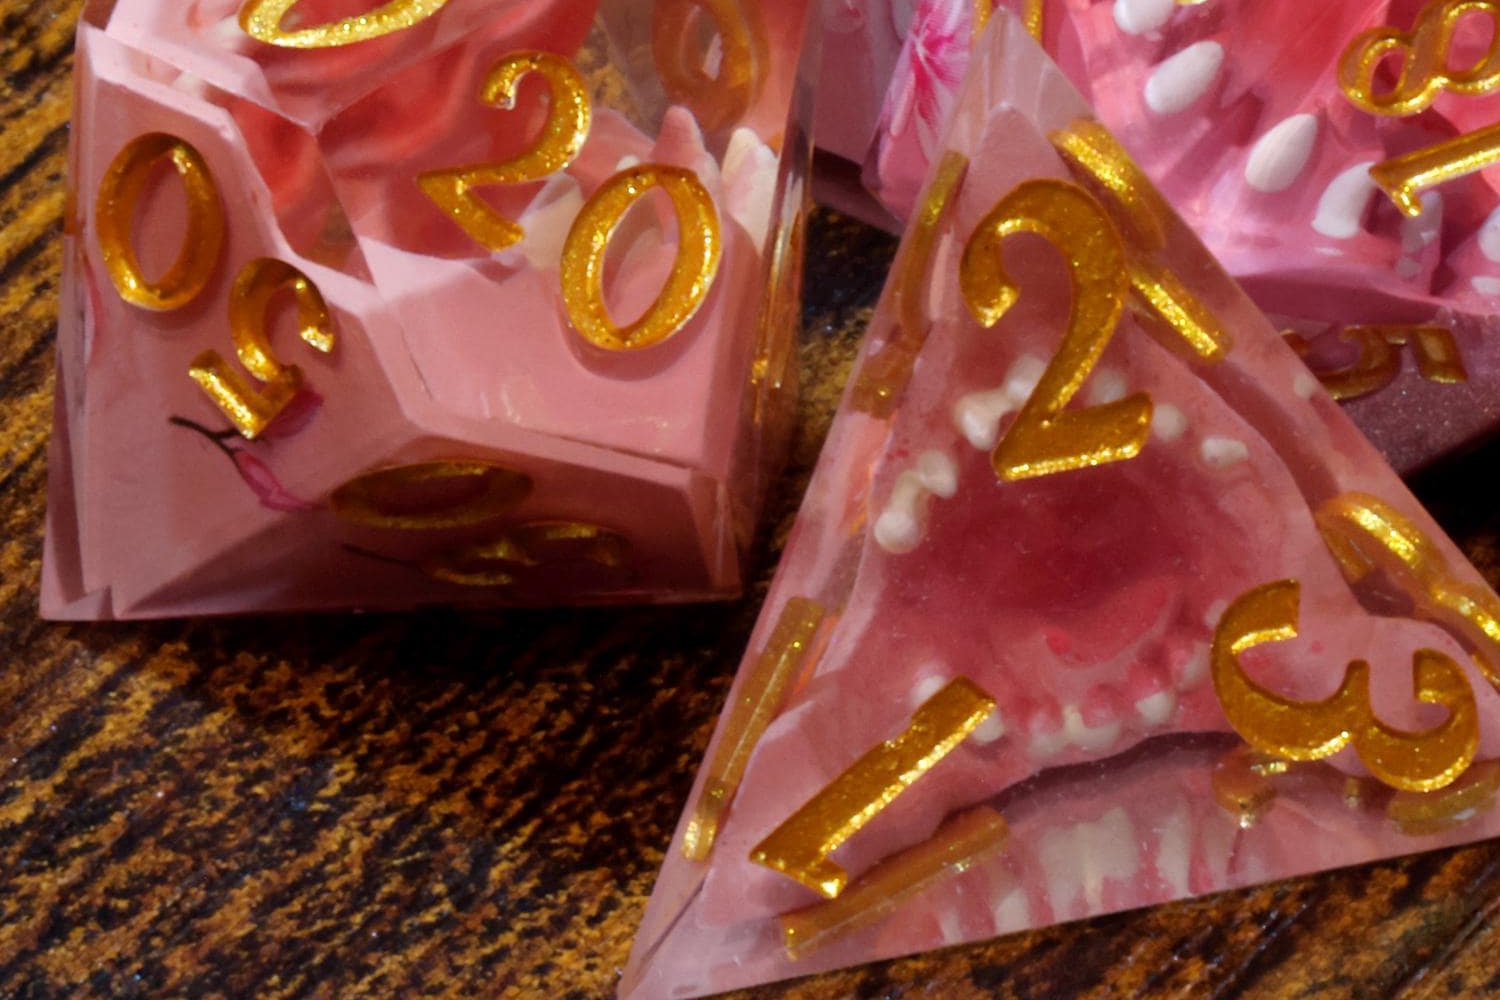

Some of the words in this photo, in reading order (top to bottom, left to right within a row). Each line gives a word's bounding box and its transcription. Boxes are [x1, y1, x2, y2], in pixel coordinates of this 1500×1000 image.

[96, 132, 335, 440] 50
[417, 51, 722, 351] 20
[959, 180, 1154, 480] 2
[749, 676, 997, 899] 1
[1211, 578, 1480, 793] 3
